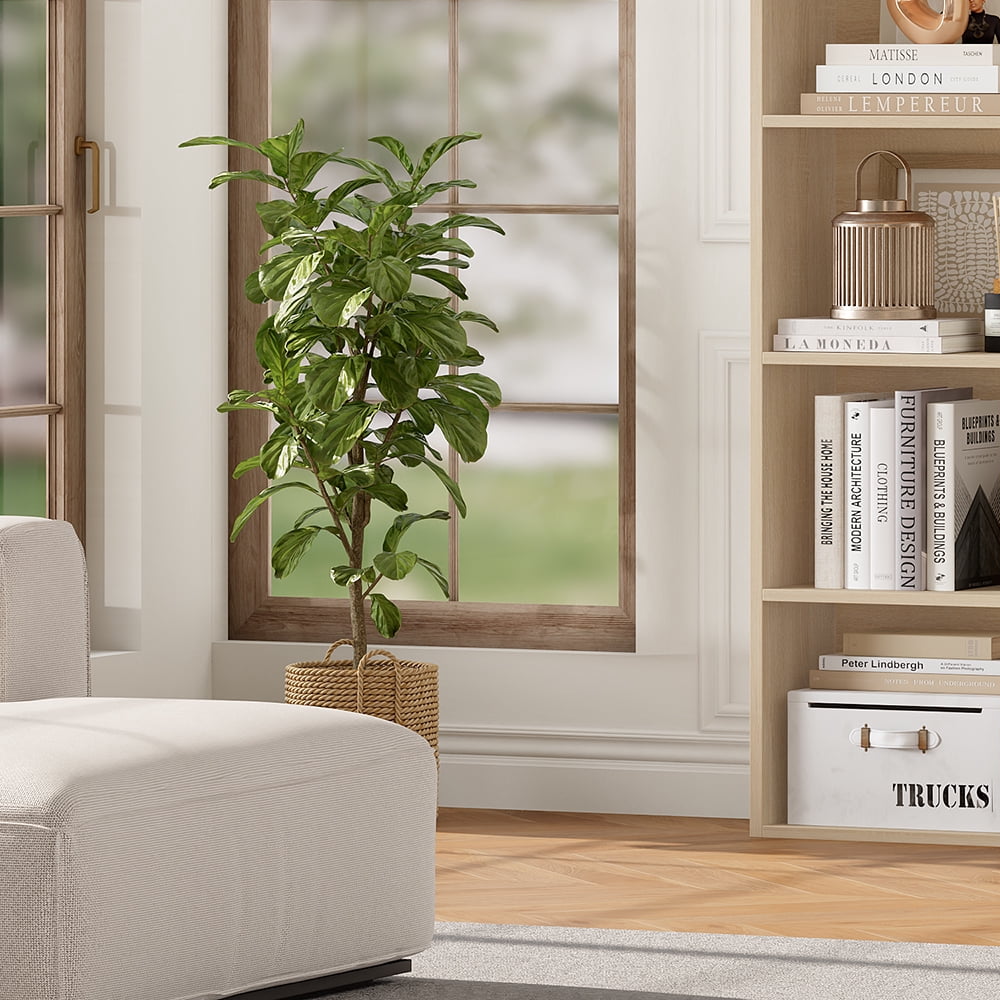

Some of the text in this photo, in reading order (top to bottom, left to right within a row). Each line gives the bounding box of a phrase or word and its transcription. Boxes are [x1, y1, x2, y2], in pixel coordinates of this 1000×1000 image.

[869, 48, 919, 61] MATISSE
[872, 72, 943, 85] LONDON
[848, 96, 984, 113] LEMPEREUR
[784, 337, 891, 351] LA MONEDA
[961, 415, 994, 430] BLUEPRINTS
[966, 430, 996, 445] BUILDINGS
[851, 432, 862, 508] ARCHITECTURE
[933, 439, 945, 500] BLUEPRINTS
[820, 438, 833, 545] BRINGING THE HOUSE HOME
[877, 462, 888, 523] CLOTHING
[900, 395, 916, 589] FURNITURE DESIGN
[851, 510, 862, 552] MODERN
[933, 512, 945, 564] BUILDINGS
[841, 658, 869, 669] Peter
[871, 659, 924, 672] Lindbergh
[938, 680, 996, 689] UNDERGROUND
[892, 783, 990, 808] TRUCKS
